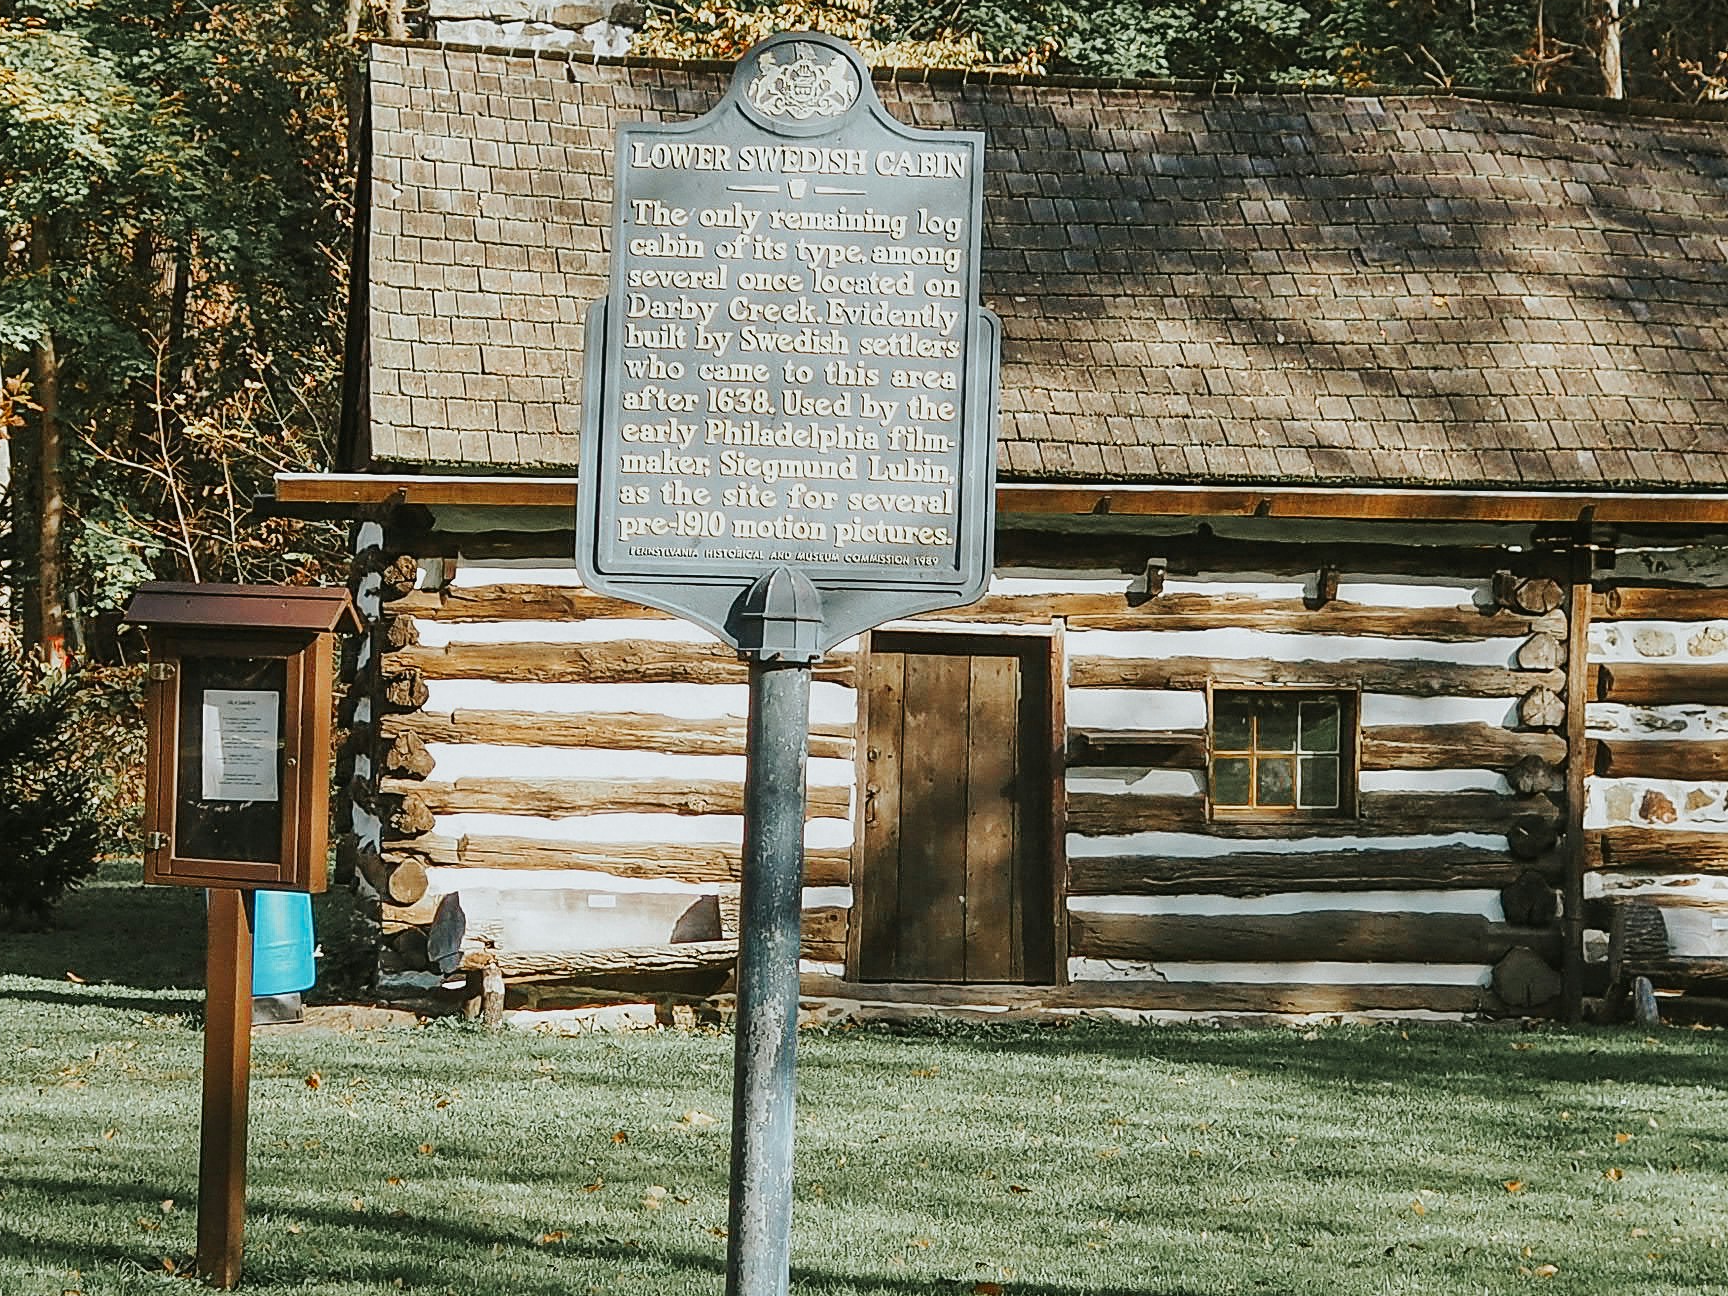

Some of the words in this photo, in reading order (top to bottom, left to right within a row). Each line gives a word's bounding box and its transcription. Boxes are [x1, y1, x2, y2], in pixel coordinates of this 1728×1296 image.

[632, 142, 731, 170] LOWER
[738, 146, 867, 175] SWEDISH
[875, 150, 968, 179] CABIN
[631, 200, 688, 225] The
[698, 202, 760, 234] only
[770, 206, 908, 239] remaining
[917, 208, 962, 242] log
[628, 231, 704, 259] cabin
[715, 234, 750, 260] of
[753, 234, 788, 261] its
[795, 237, 866, 270] type,
[871, 246, 962, 272] among
[628, 264, 728, 290] several
[737, 271, 802, 294] once
[813, 267, 915, 296] located
[924, 276, 961, 298] on
[627, 294, 719, 324] Darby
[728, 296, 824, 324] Creek.
[826, 299, 959, 332] Evidently
[625, 324, 686, 350] built
[695, 326, 732, 356] by
[740, 328, 850, 356] Swedish
[859, 332, 960, 358] settlers
[624, 354, 685, 379] who
[698, 362, 770, 384] came
[782, 361, 814, 384] to
[824, 359, 880, 387] this
[891, 368, 957, 390] area
[622, 386, 698, 413] after
[706, 387, 776, 416] 1638.
[782, 390, 852, 418] Used
[860, 394, 899, 426] by
[907, 396, 956, 422] the
[622, 418, 698, 451] early
[705, 420, 880, 454] Philadelphia
[887, 426, 956, 453] film-
[620, 450, 709, 480] maker,
[719, 450, 856, 482] Siegmund
[868, 455, 955, 486] Lubin,
[619, 485, 651, 506] as
[660, 482, 710, 508] the
[722, 484, 776, 510] site
[787, 482, 838, 510] for
[848, 488, 953, 516] several
[617, 510, 726, 543] pre-1910
[731, 515, 827, 541] motion
[833, 520, 954, 548] pictures.
[629, 545, 698, 559] PENNSYLVANIA
[704, 548, 765, 561] HISTORICAL
[769, 551, 792, 561] AND
[795, 552, 840, 564] MUSEUM
[844, 552, 909, 566] COMMISSION
[913, 555, 939, 566] 1989
